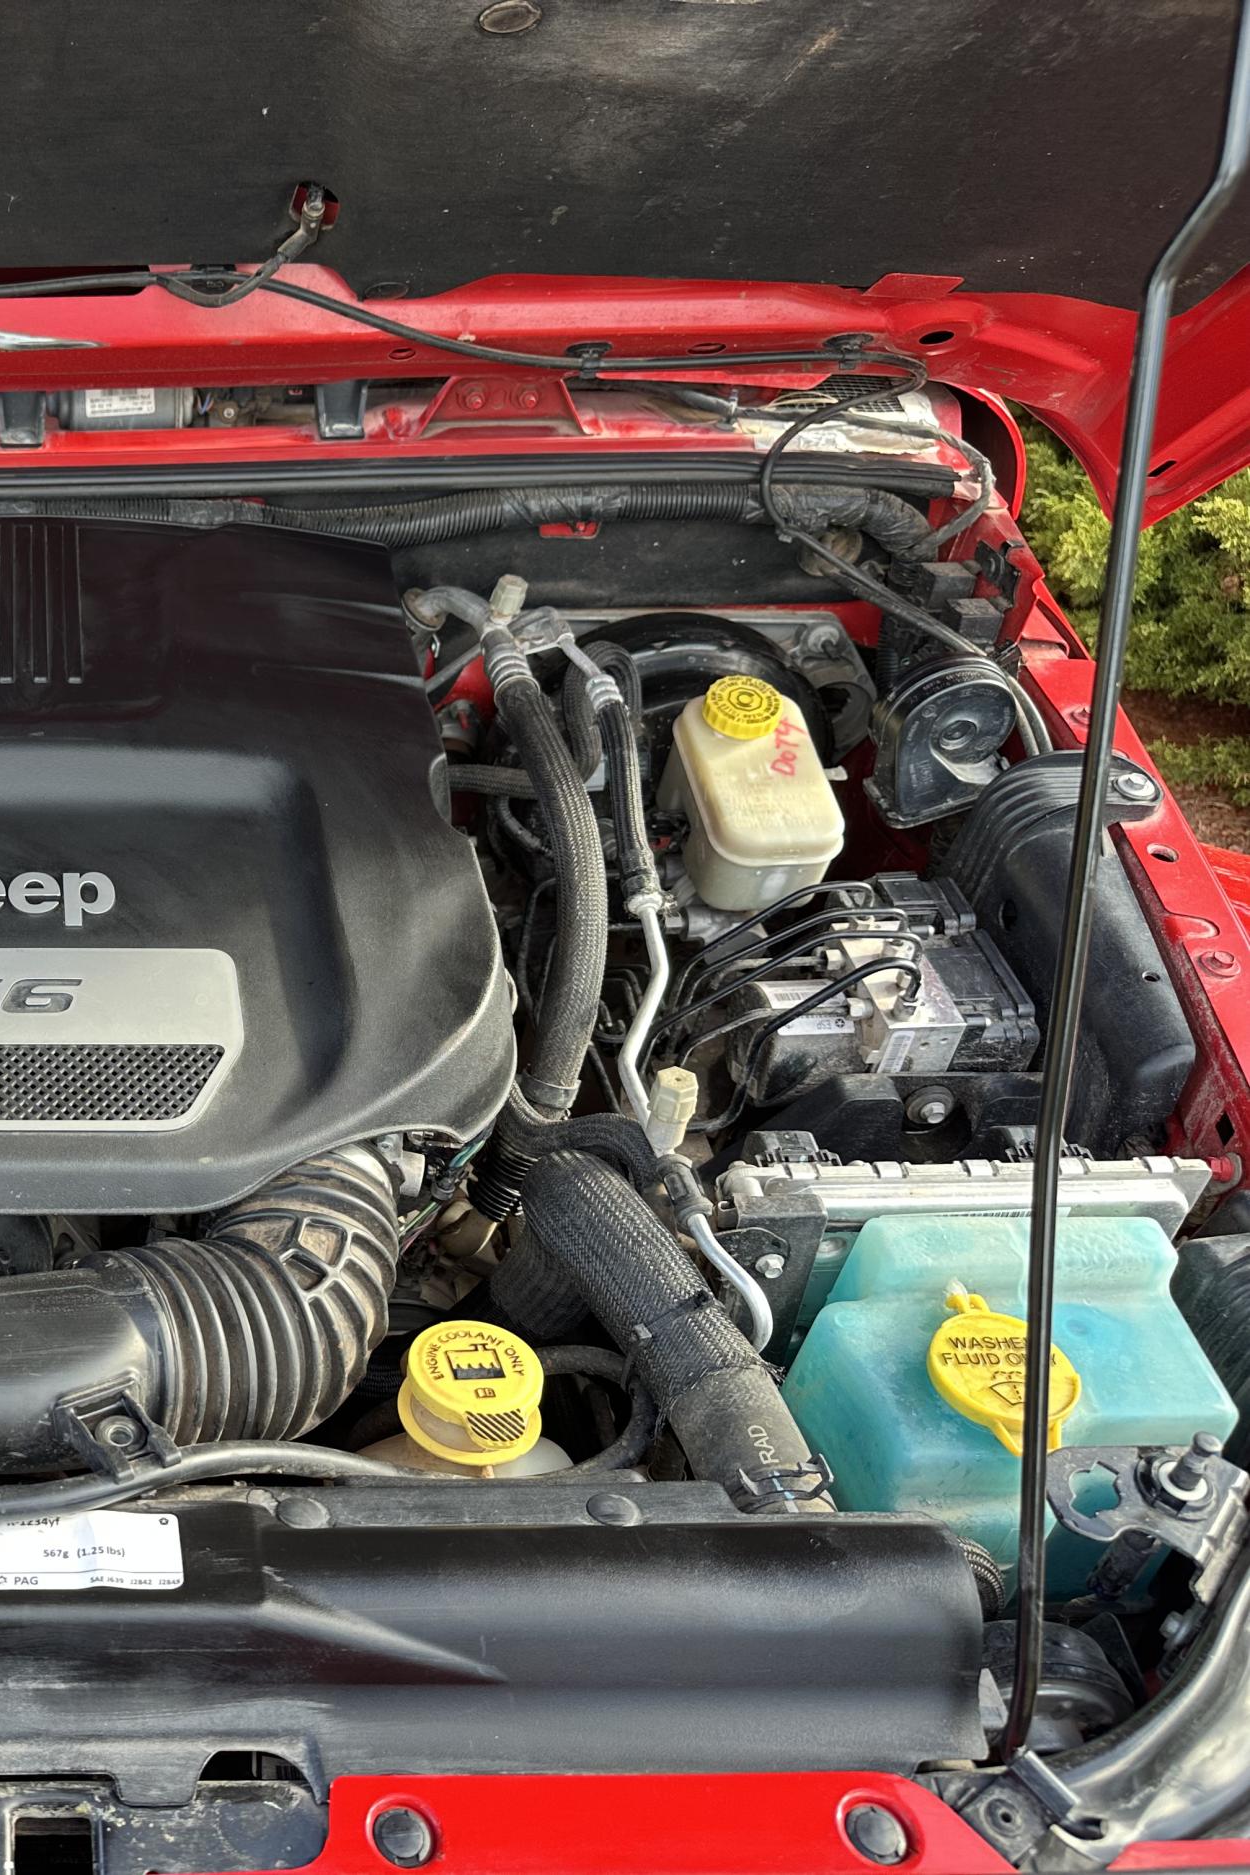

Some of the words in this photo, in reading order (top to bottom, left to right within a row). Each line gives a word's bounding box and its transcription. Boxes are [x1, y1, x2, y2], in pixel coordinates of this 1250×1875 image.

[949, 1336, 1028, 1350] WASHE
[425, 1343, 444, 1381] ENGINE
[437, 1330, 505, 1347] COOLANT
[504, 1345, 525, 1377] ONLY
[941, 1353, 1000, 1366] FLUID
[747, 1424, 780, 1466] RAD
[43, 1549, 70, 1559] 567g
[76, 1546, 104, 1559] (1.25
[106, 1546, 126, 1557] lbs)
[13, 1576, 39, 1586] PAG
